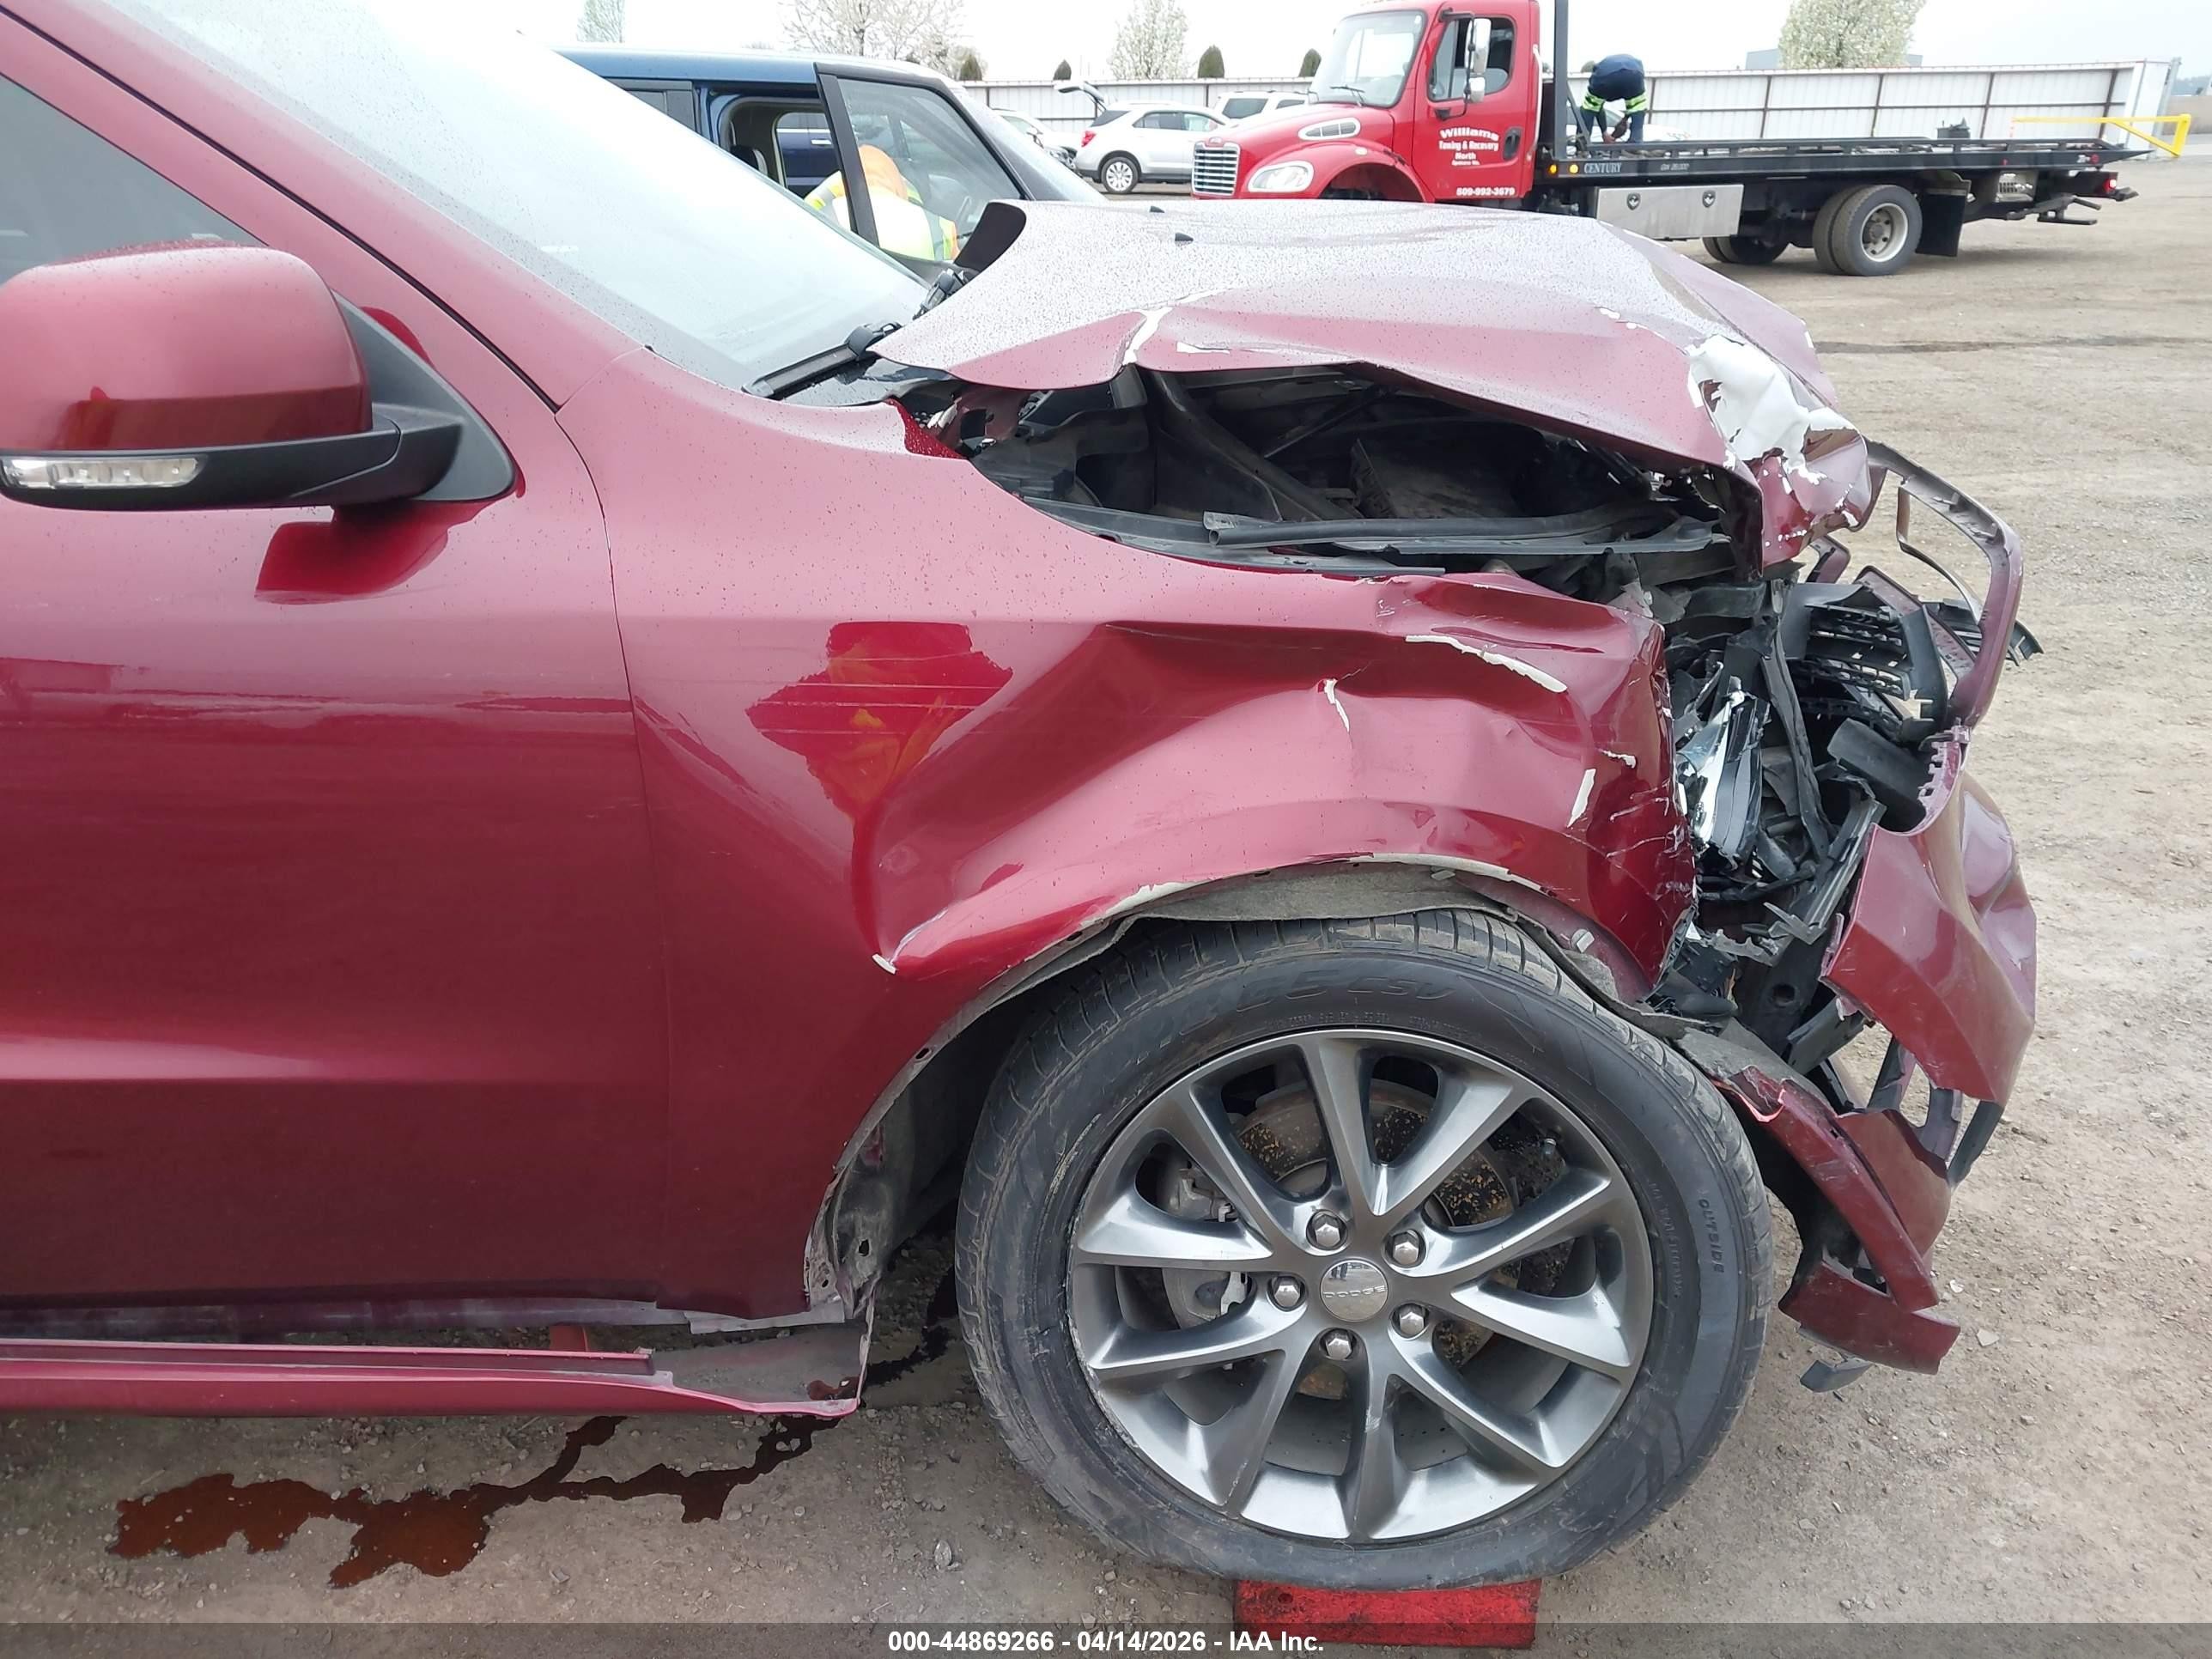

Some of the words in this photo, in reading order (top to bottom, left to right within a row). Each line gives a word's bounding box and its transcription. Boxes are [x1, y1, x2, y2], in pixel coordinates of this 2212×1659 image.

[1440, 127, 1499, 141] Williams
[1462, 141, 1468, 149] &
[1469, 141, 1498, 151] Recovery
[1584, 162, 1622, 174] CENTURY
[1698, 1199, 1725, 1273] OUTSIDE
[1323, 1285, 1387, 1298] DODGE
